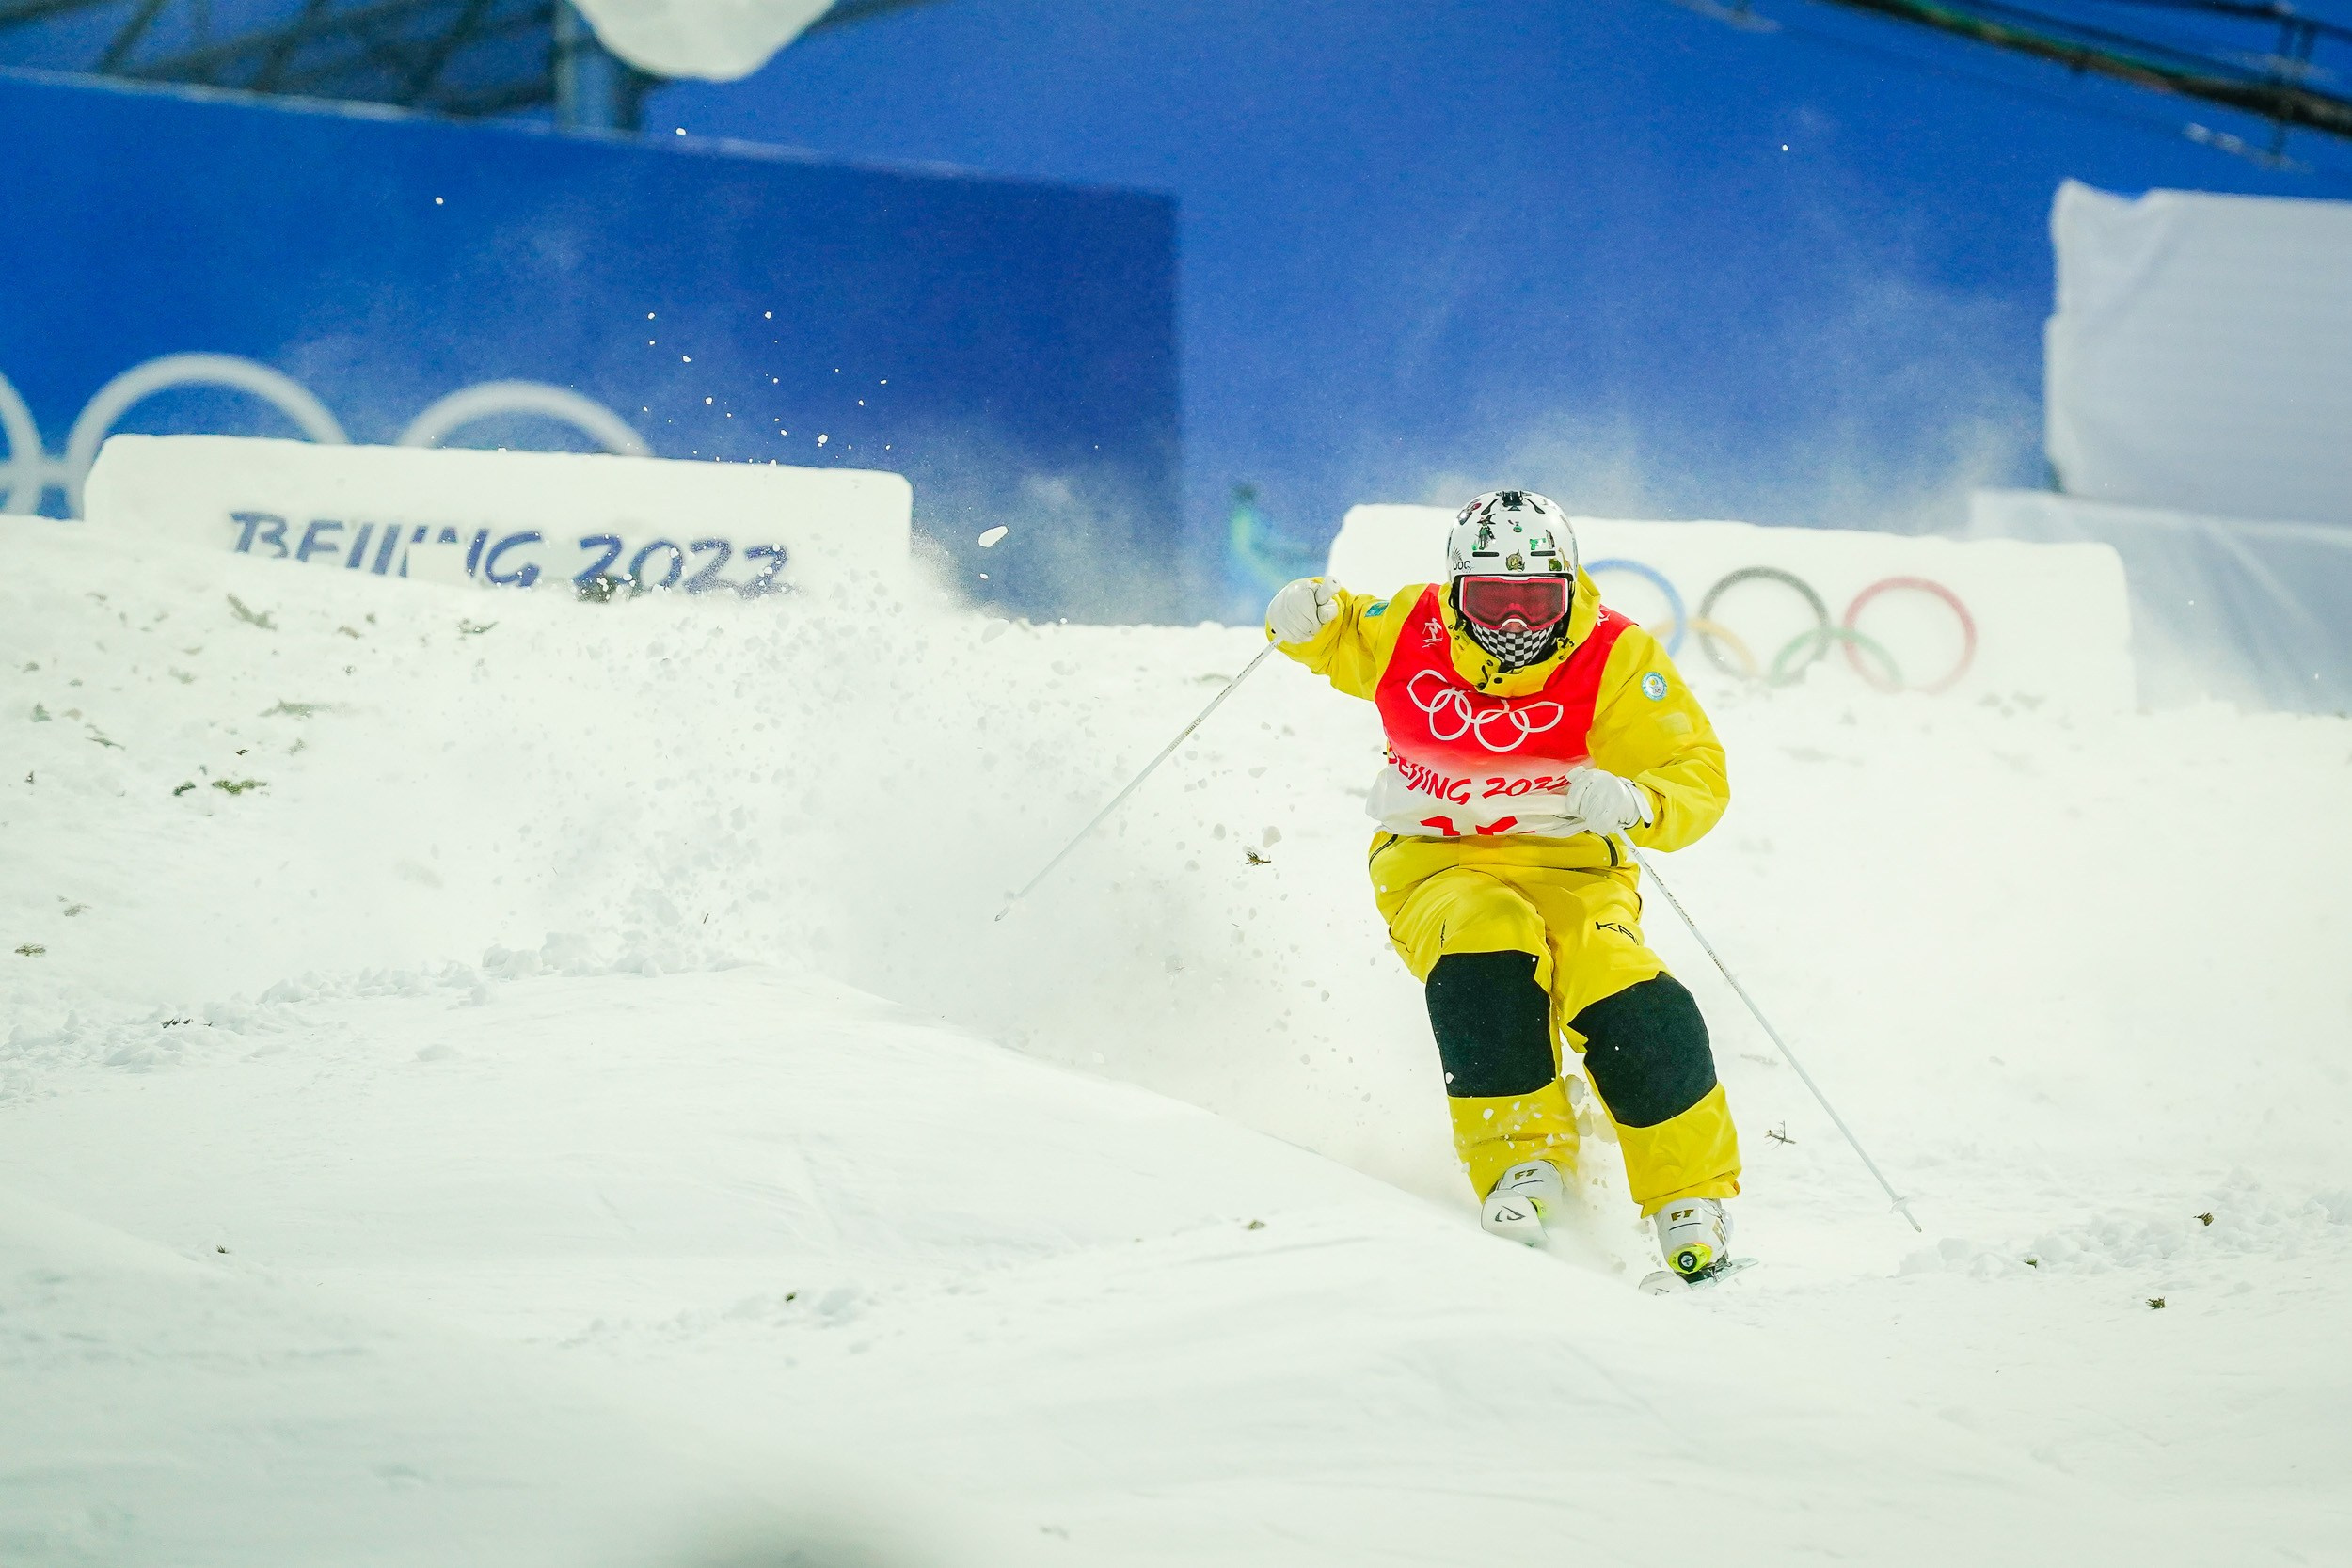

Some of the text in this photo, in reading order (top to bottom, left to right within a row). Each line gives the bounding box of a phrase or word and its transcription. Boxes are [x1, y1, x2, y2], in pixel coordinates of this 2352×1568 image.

[569, 533, 796, 601] 2022
[1481, 774, 1572, 800] 2022
[1514, 1168, 1539, 1180] FT
[1670, 1208, 1695, 1222] FT
